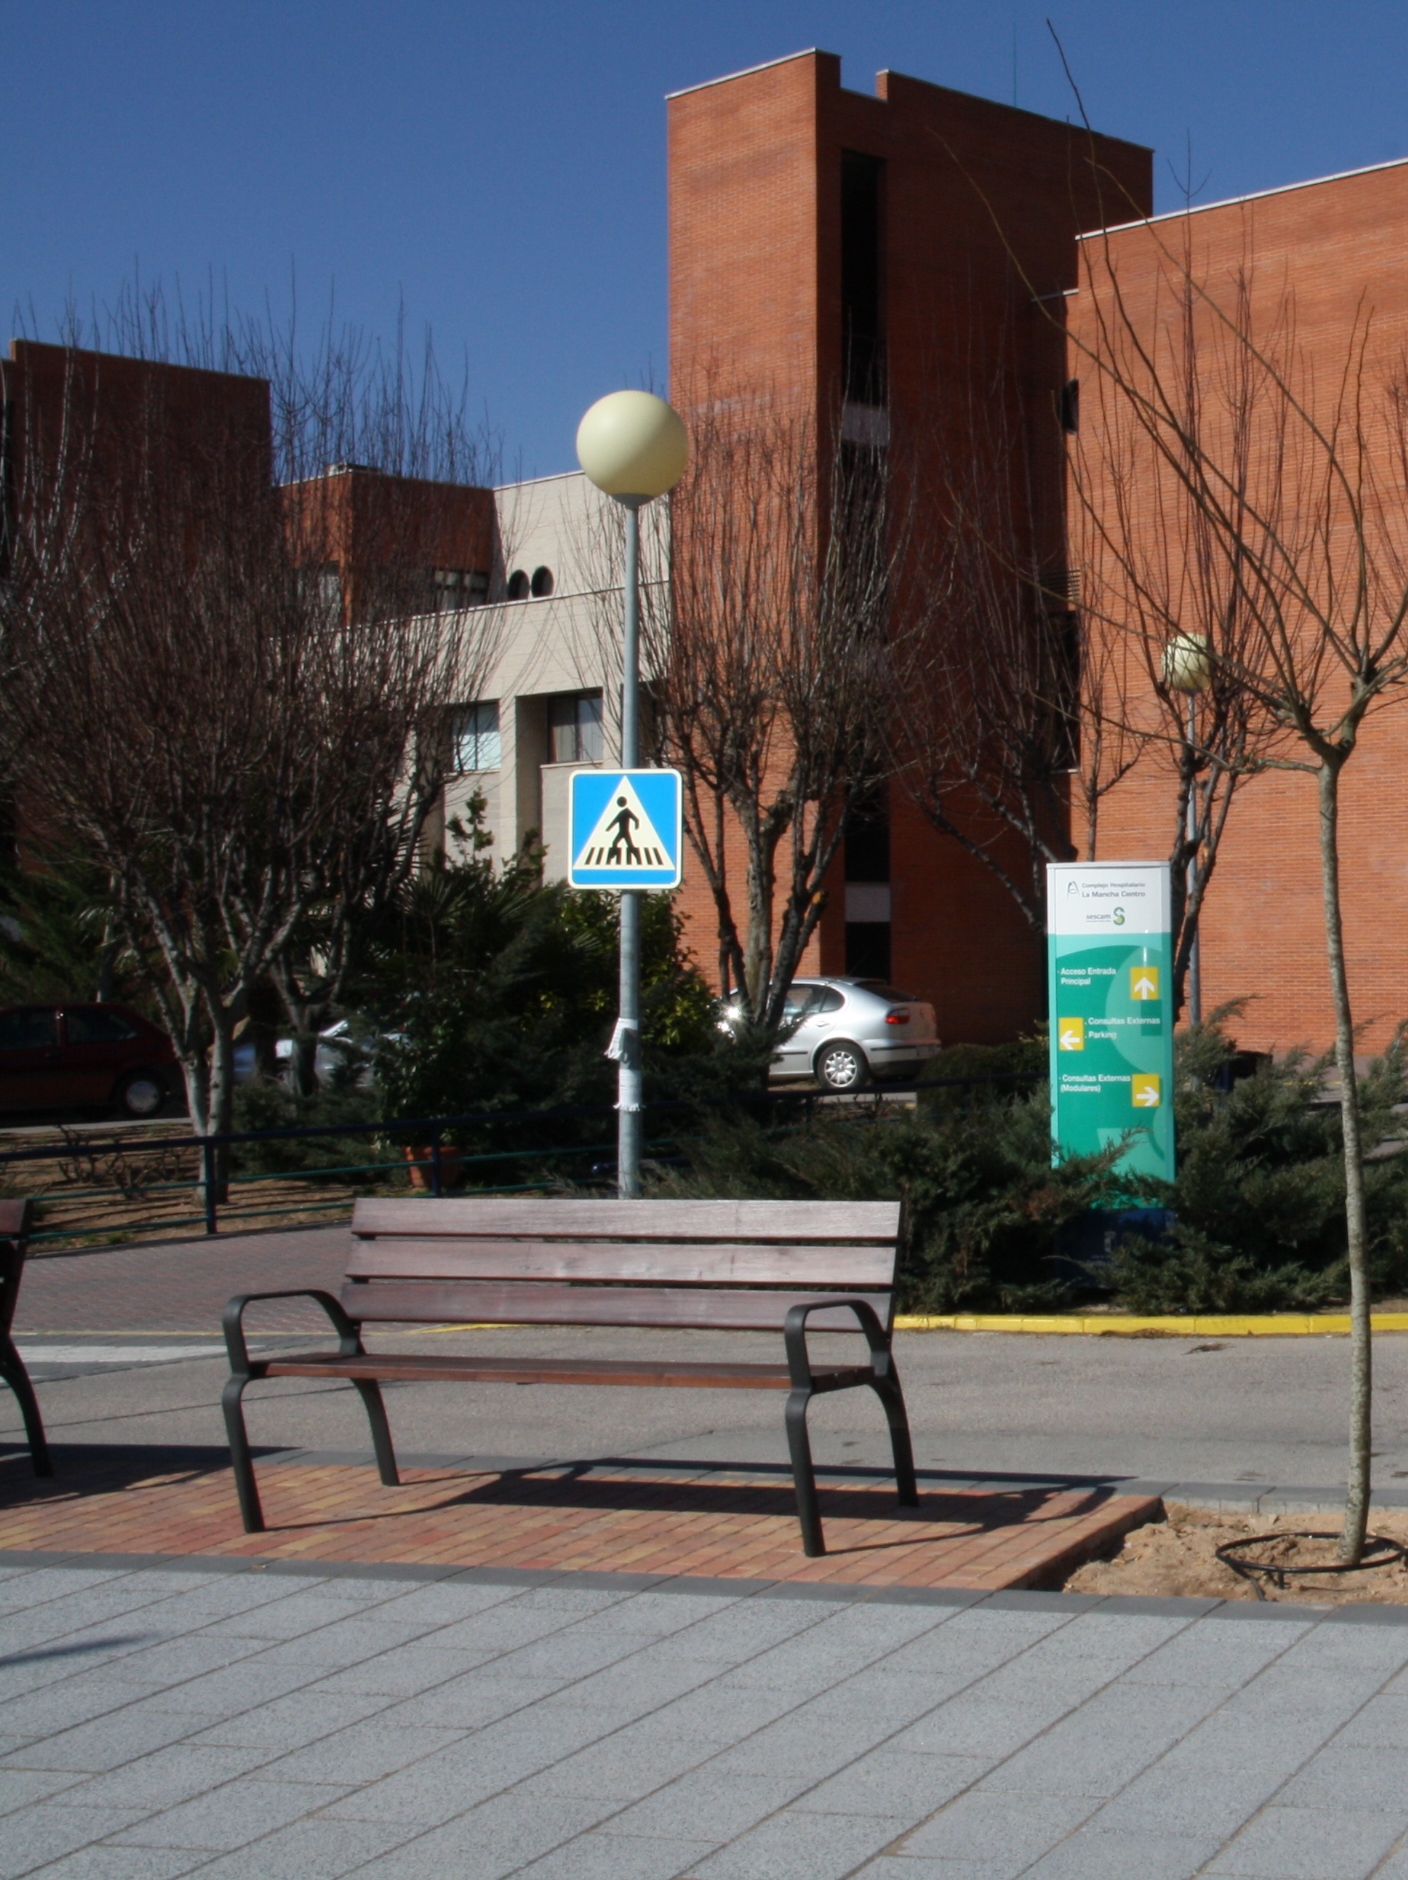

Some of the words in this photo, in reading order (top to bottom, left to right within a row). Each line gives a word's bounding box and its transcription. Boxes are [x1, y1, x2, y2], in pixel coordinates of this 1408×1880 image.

[1060, 967, 1086, 975] Acceso
[1087, 967, 1116, 975] Entrada
[1061, 977, 1091, 986] Principal
[1088, 1017, 1125, 1025] Consultas
[1127, 1016, 1161, 1025] Externas
[1088, 1031, 1117, 1040] Parking
[1062, 1074, 1097, 1082] Consultas
[1098, 1074, 1131, 1082] Externas
